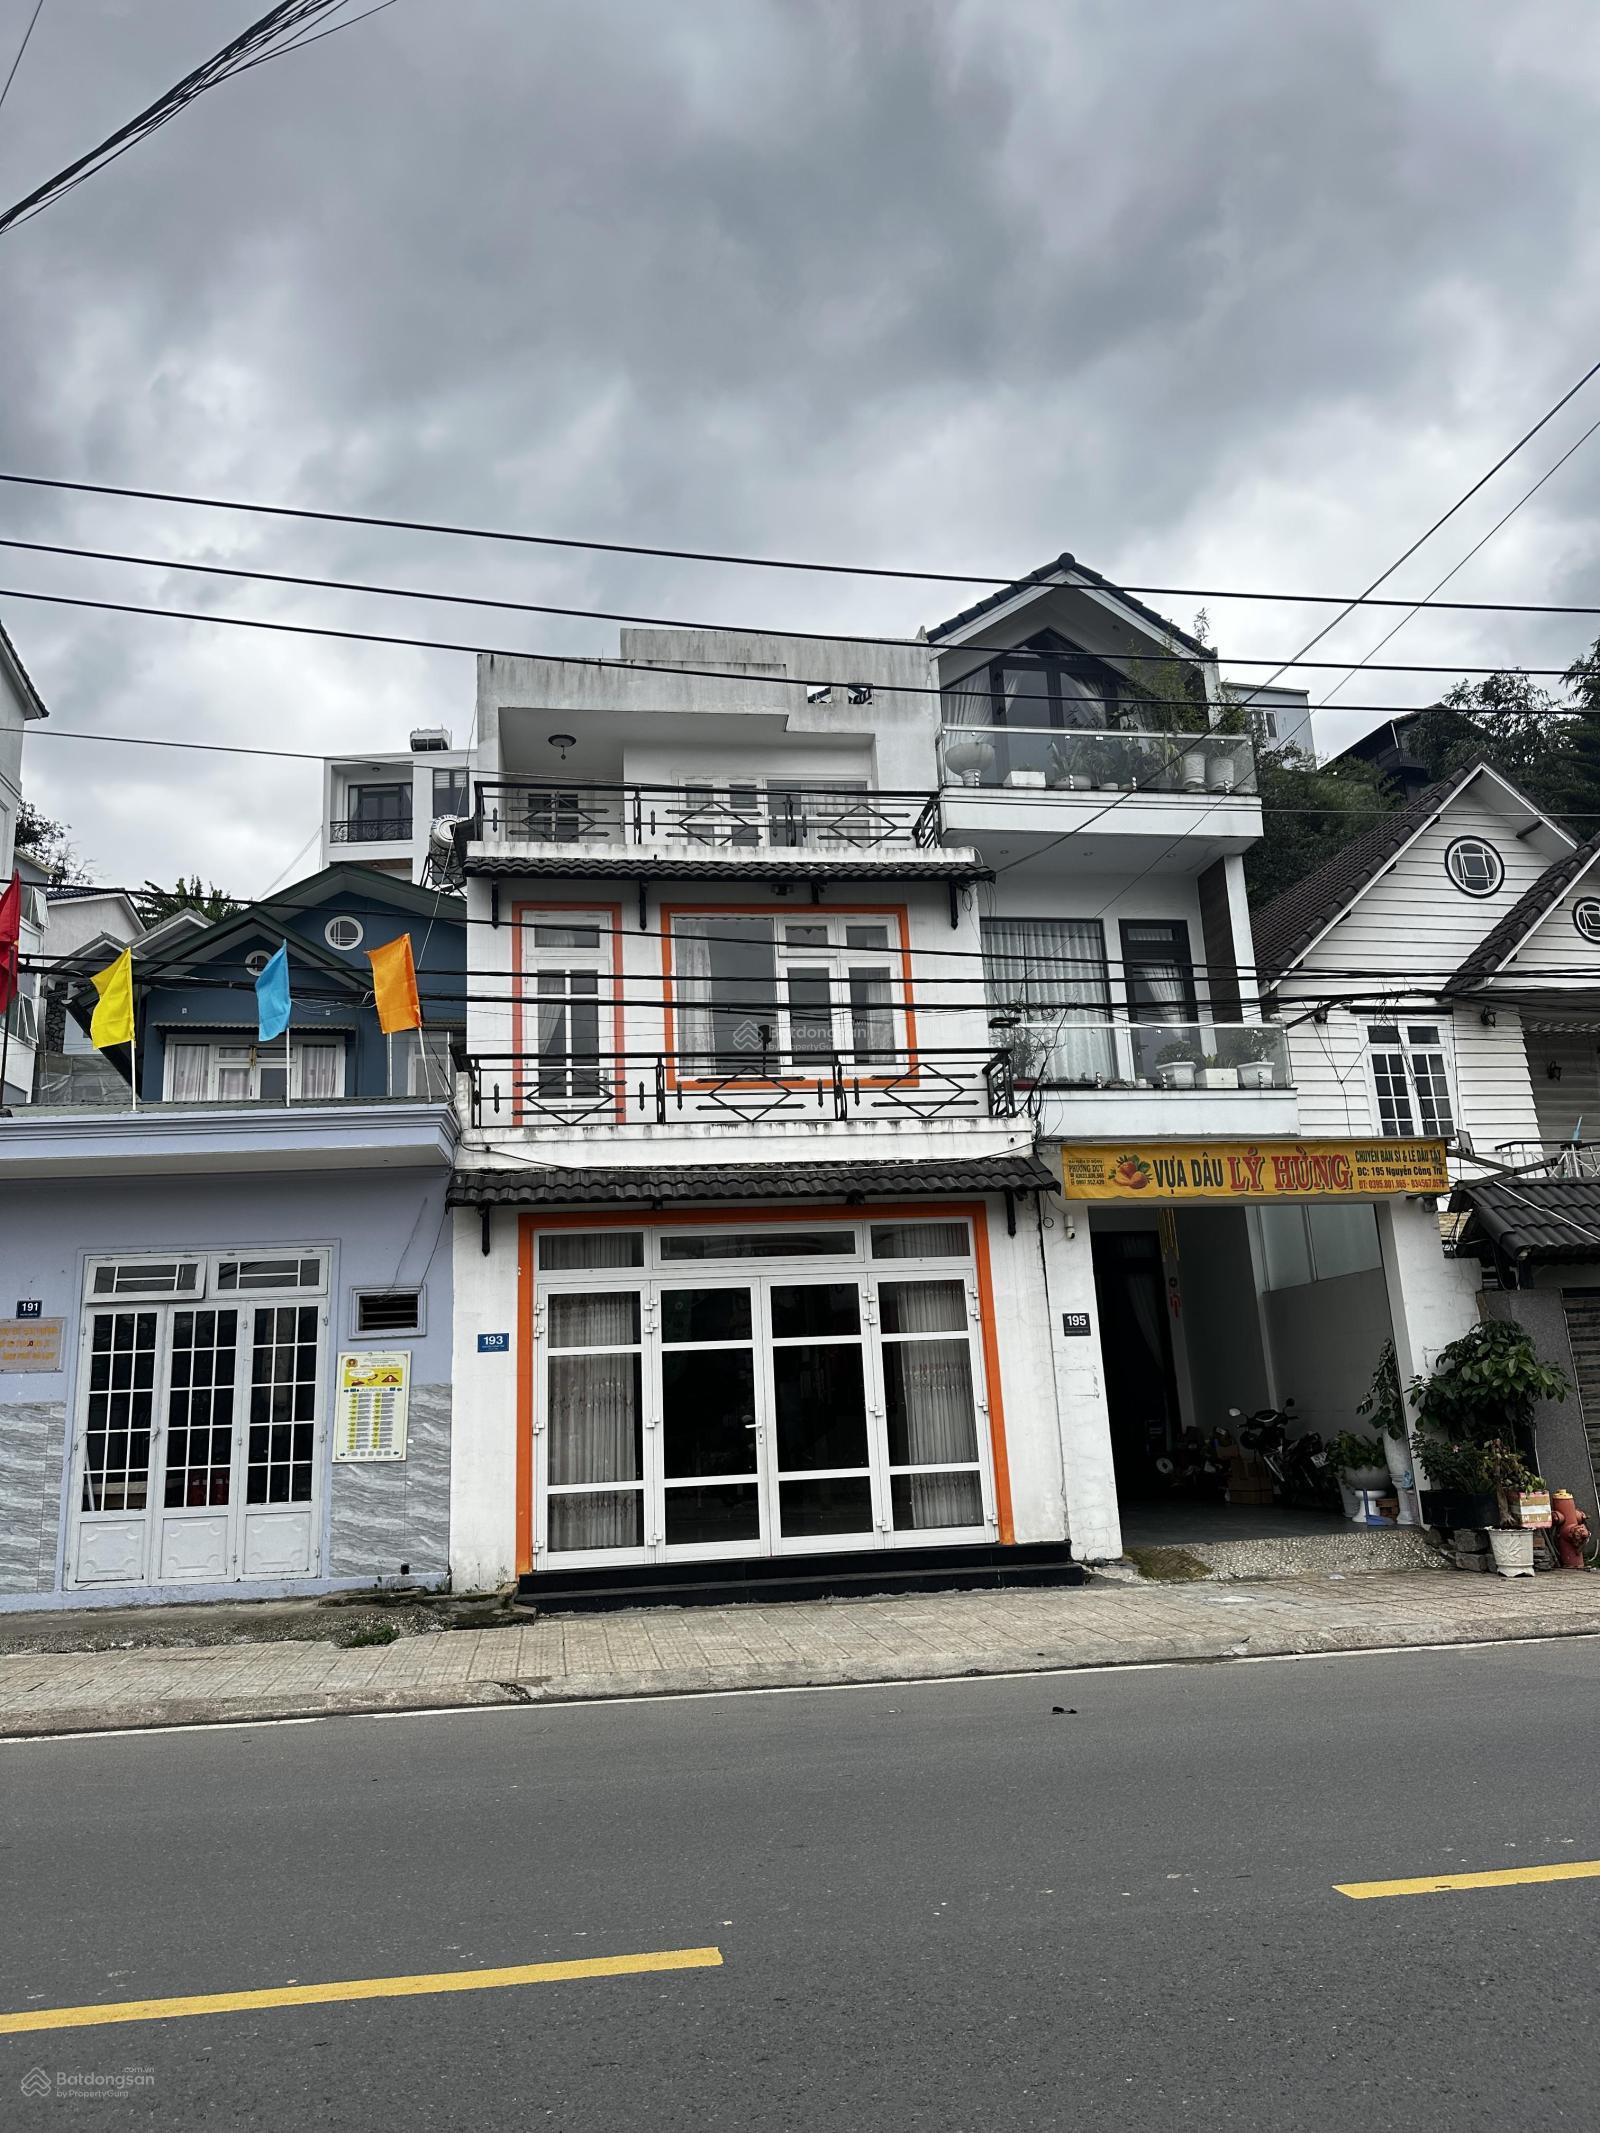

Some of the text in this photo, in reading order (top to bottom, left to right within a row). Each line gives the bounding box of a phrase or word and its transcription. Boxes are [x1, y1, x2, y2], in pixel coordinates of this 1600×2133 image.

[1354, 1147, 1379, 1163] CHUYÊN
[1380, 1147, 1393, 1163] BÁN
[1402, 1149, 1408, 1163] &
[1417, 1146, 1429, 1162] DÂU
[1152, 1155, 1188, 1195] VỰA
[1191, 1152, 1224, 1188] DÂU
[1271, 1145, 1353, 1191] HÙNG
[1357, 1167, 1370, 1177] ĐC:
[1371, 1166, 1385, 1176] 195
[1386, 1164, 1412, 1177] Nguyễn
[1413, 1165, 1432, 1177] Công
[21, 1302, 39, 1312] 191
[1066, 1314, 1087, 1326] 195
[483, 1335, 504, 1345] 193
